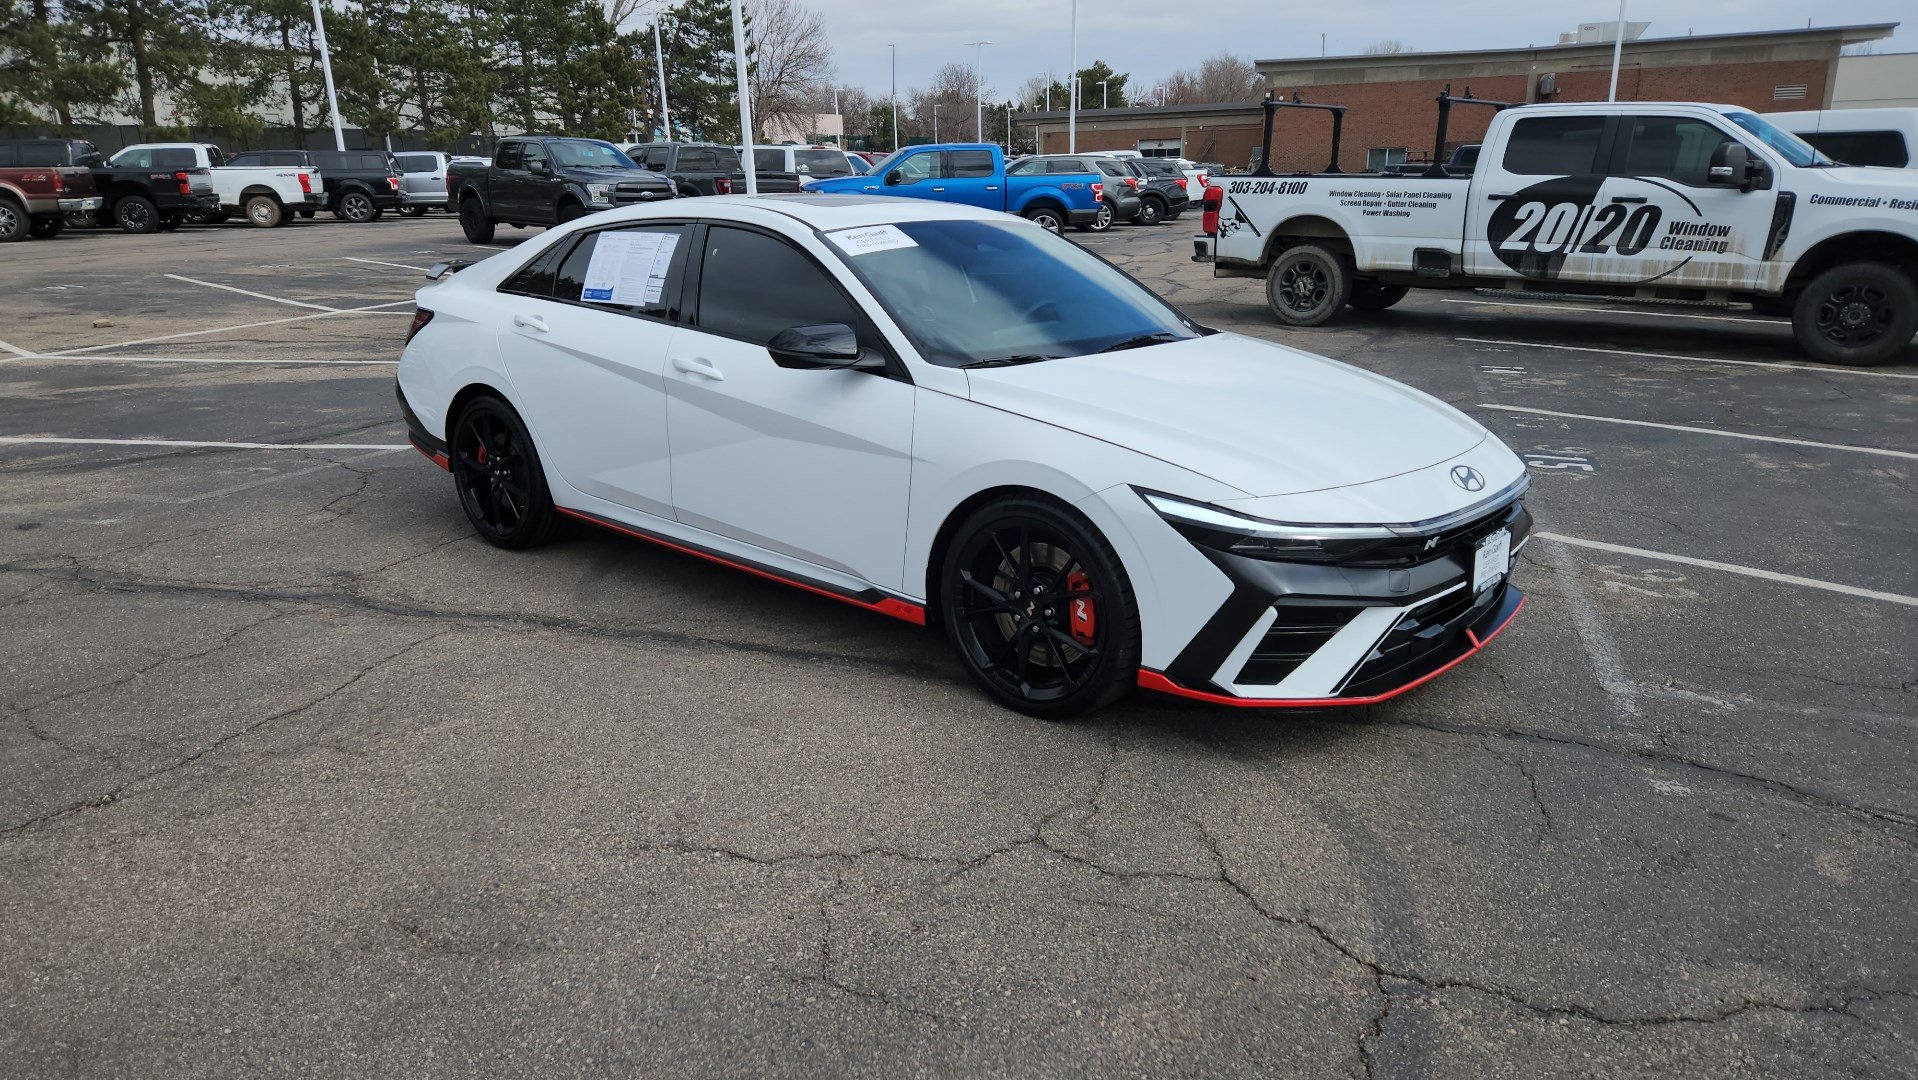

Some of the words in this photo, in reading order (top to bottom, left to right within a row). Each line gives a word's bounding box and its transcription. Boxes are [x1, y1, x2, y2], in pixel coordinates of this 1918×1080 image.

[1228, 181, 1309, 195] 303-204-8100
[1329, 190, 1353, 198] Window
[1353, 190, 1381, 199] Cleaning
[1385, 190, 1403, 198] Solar
[1403, 191, 1422, 199] Panel
[1422, 191, 1452, 200] Cleaning
[1339, 199, 1362, 207] Screen
[1362, 200, 1383, 208] Repair
[1387, 200, 1408, 208] Gutter
[1408, 200, 1437, 209] Cleaning
[1809, 193, 1882, 208] Commercial
[1362, 209, 1382, 217] Power
[1382, 209, 1411, 218] Washing
[1668, 221, 1732, 237] Window
[1659, 236, 1729, 254] Cleaning
